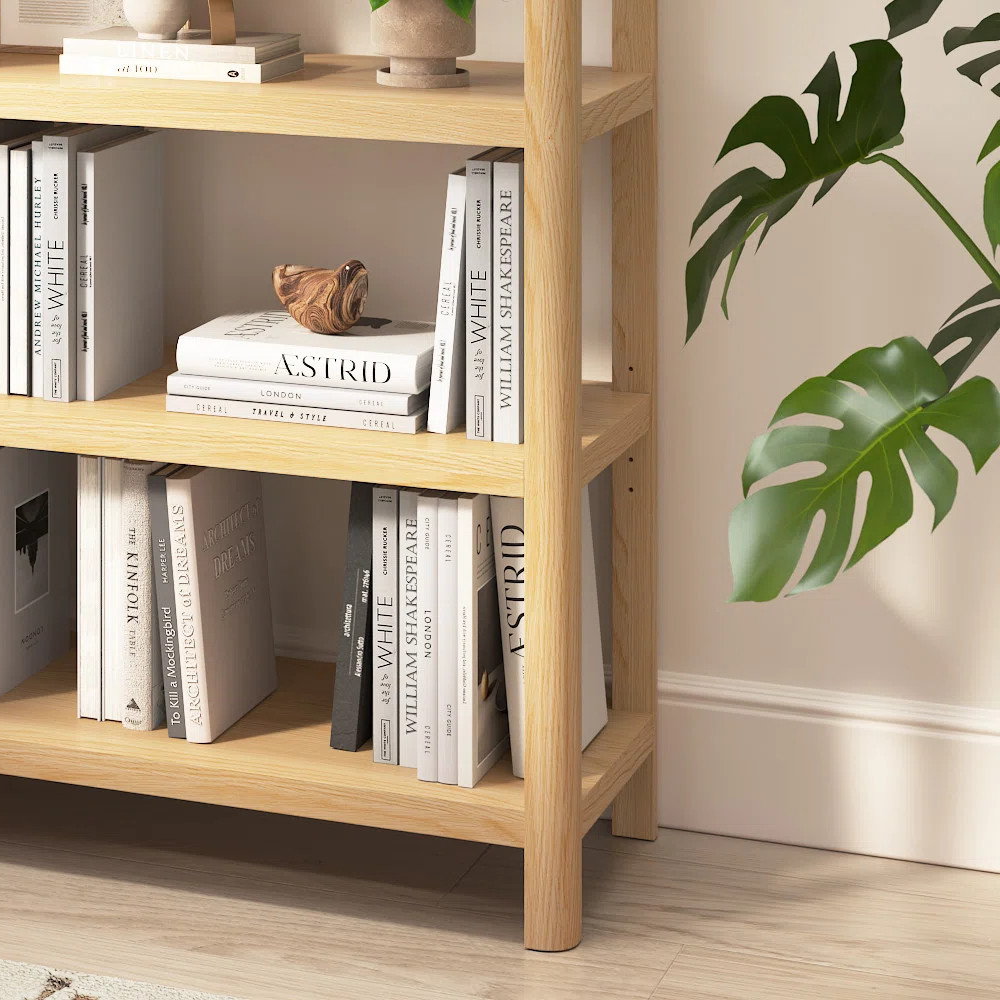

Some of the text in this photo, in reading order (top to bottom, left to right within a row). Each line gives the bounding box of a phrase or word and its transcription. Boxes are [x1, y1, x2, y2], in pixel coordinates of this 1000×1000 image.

[34, 177, 42, 356] ANDREW MICHAEL HURLEY
[47, 240, 64, 310] WHITE
[440, 281, 452, 316] CEREAL
[470, 270, 487, 344] WHITE
[499, 190, 512, 410] WILLIAM SHAKESPEARE
[274, 353, 391, 384] ÆSTRID
[196, 403, 228, 414] CEREAL
[252, 408, 285, 418] TRAVEL
[300, 413, 327, 422] STYLE
[260, 389, 302, 400] LONDON
[362, 418, 395, 430] CEREAL
[128, 527, 136, 546] THE
[158, 538, 169, 584] HARPER LEE
[126, 552, 139, 624] KINFOLK
[171, 505, 202, 726] ARCHITECT of DREAMS
[377, 596, 393, 669] WHITE
[405, 518, 418, 735] WILLIAM SHAKESPEARE
[424, 610, 432, 658] LONDON
[162, 607, 177, 679] Mockingbird
[168, 691, 179, 708] Kill
[170, 711, 181, 726] To
